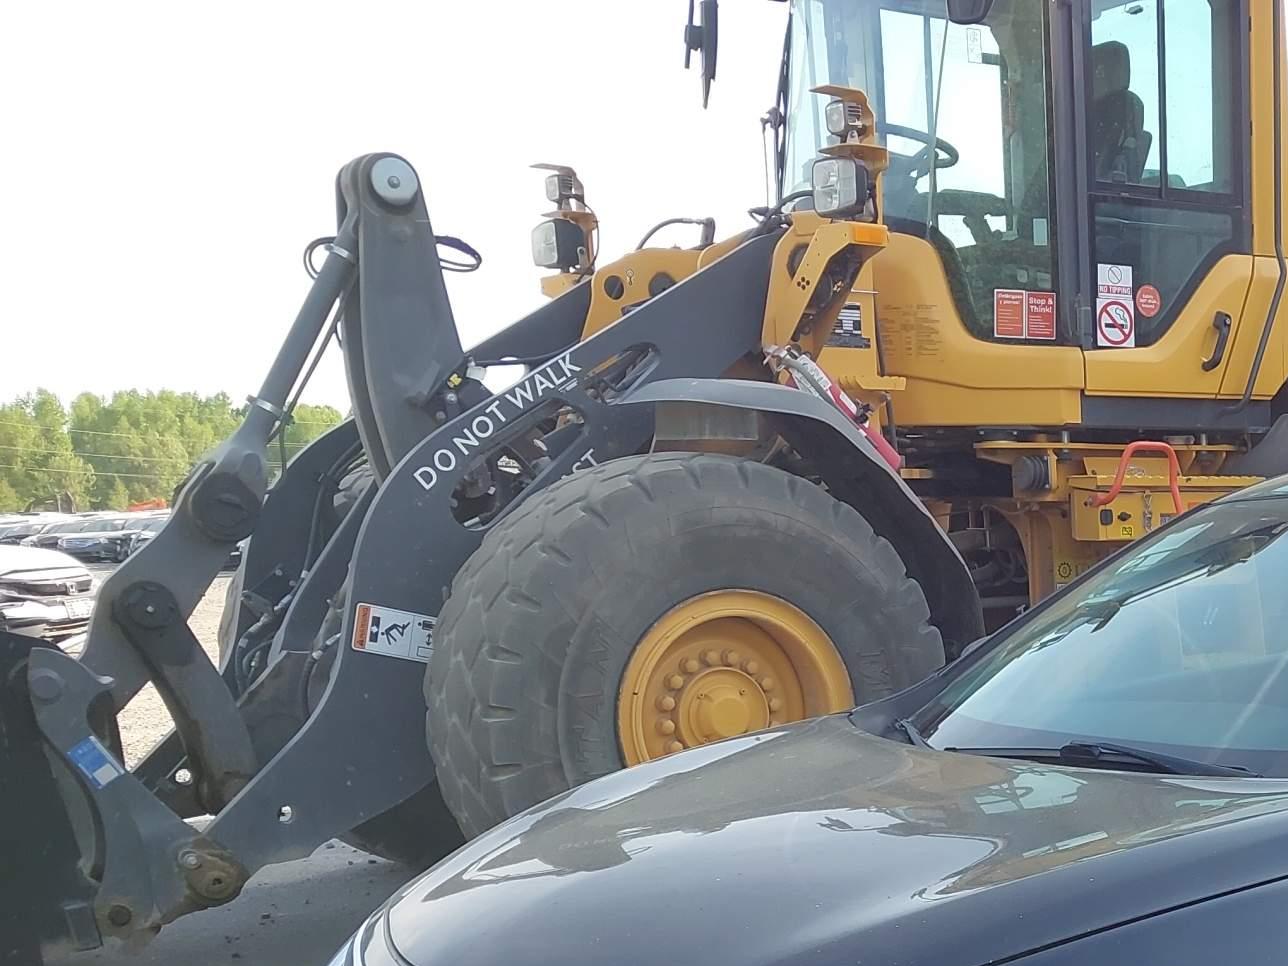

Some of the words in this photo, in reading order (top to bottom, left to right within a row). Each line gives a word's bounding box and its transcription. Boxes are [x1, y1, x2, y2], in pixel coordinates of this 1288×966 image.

[1099, 285, 1108, 293] NO
[1109, 286, 1131, 295] TIPPING
[1029, 297, 1046, 305] Stop
[1029, 305, 1052, 313] Think!
[413, 449, 456, 490] DO
[452, 400, 507, 456] NOT
[504, 352, 582, 409] WALK
